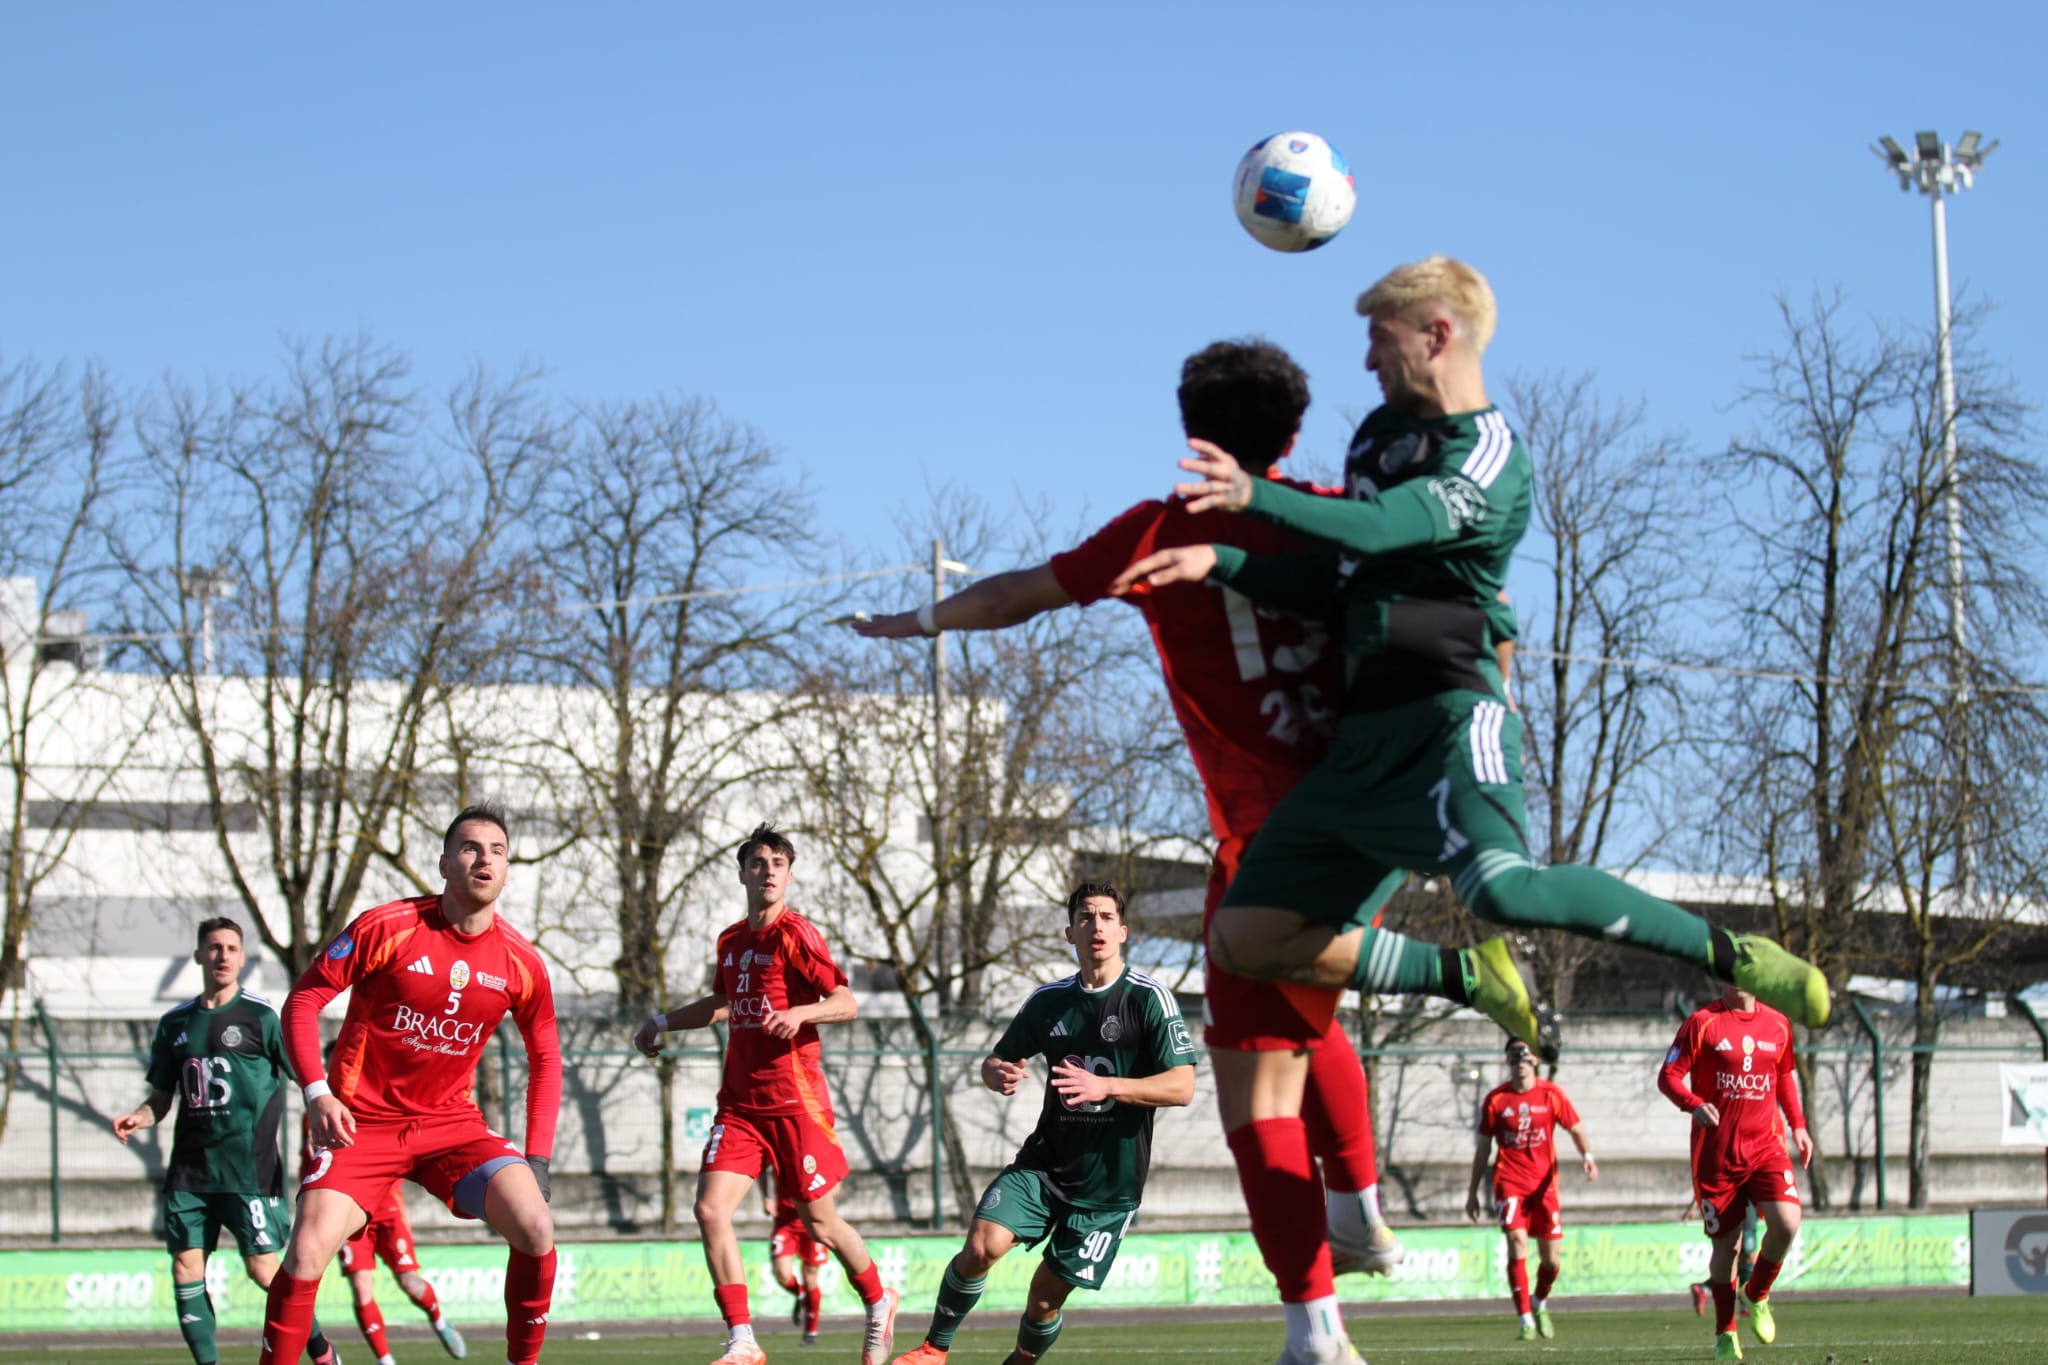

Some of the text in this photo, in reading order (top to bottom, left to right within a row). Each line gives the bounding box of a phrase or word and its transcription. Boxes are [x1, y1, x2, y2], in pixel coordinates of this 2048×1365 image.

[736, 973, 750, 993] 21
[444, 991, 462, 1015] 5
[392, 1004, 484, 1045] BRACCA
[1743, 1055, 1753, 1073] 8
[1716, 1071, 1771, 1092] BRACCA
[248, 1198, 267, 1230] 8
[1701, 1198, 1720, 1235] 8
[1078, 1231, 1113, 1263] 90
